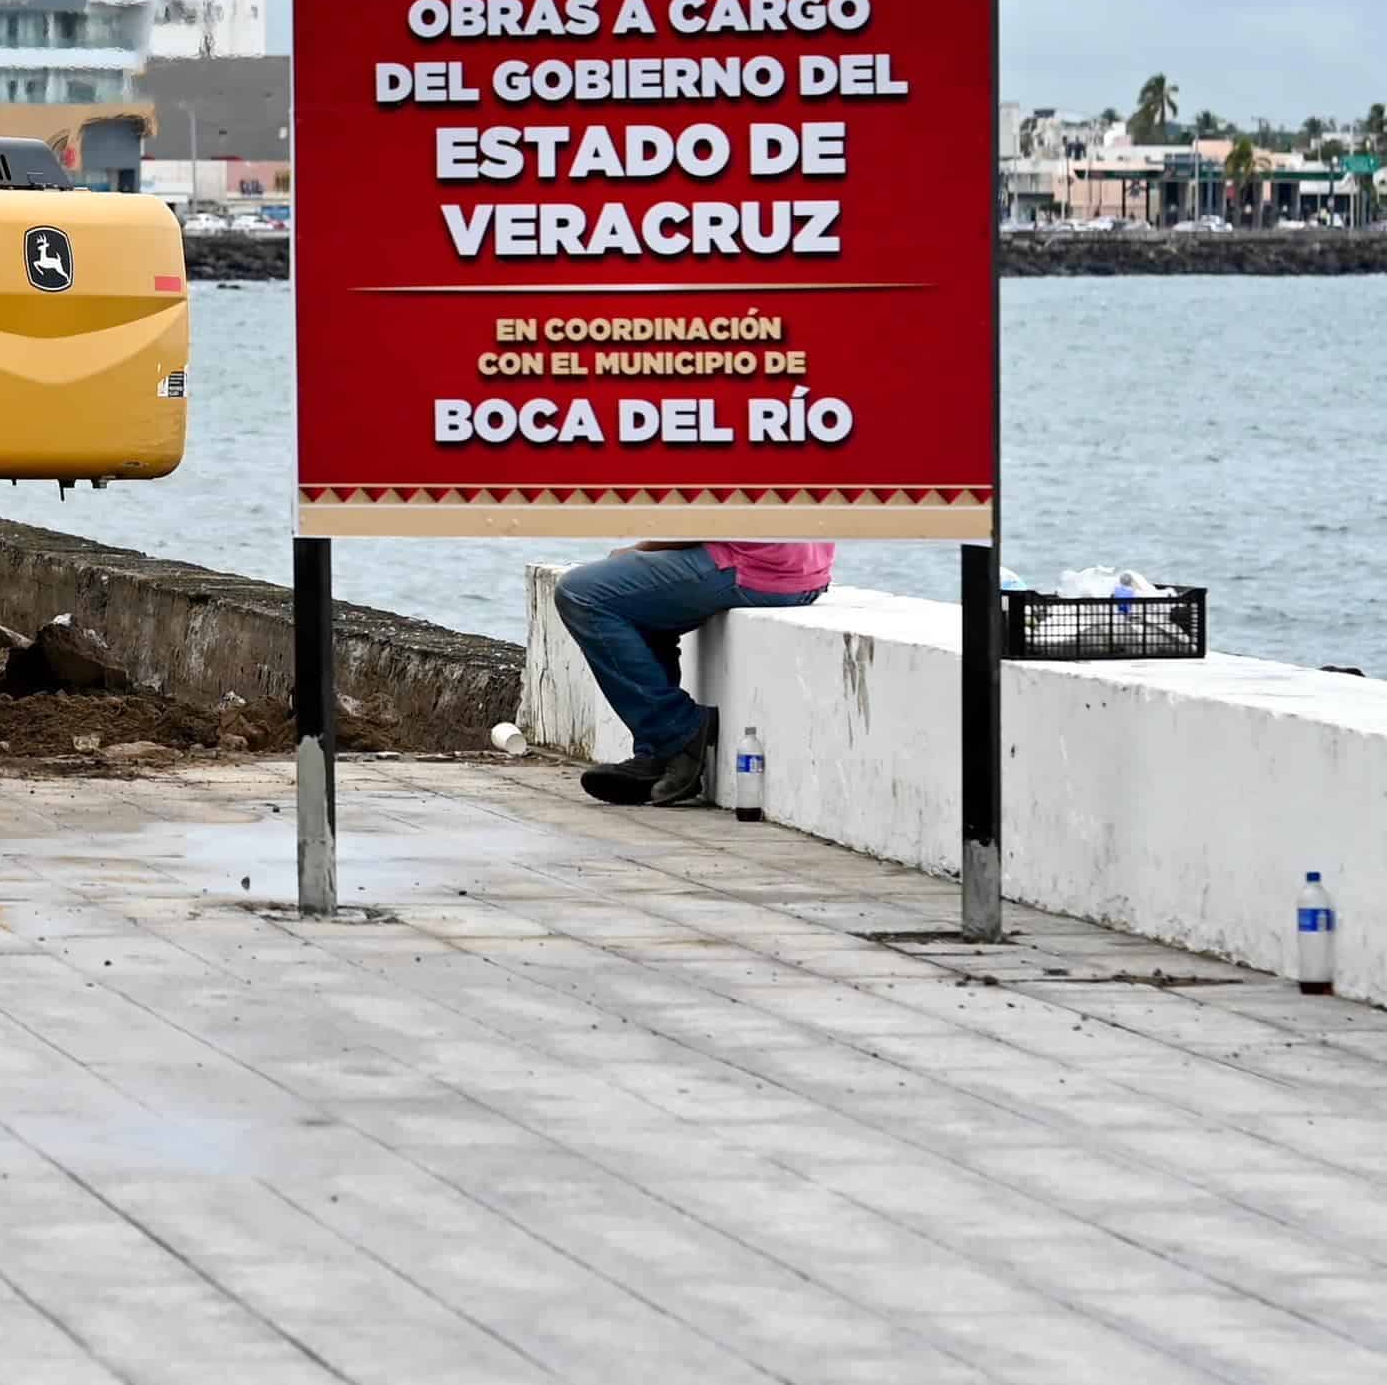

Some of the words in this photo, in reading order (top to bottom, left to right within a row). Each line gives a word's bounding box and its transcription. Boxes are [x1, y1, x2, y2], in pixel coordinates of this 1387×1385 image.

[376, 61, 479, 102] DEL
[492, 56, 785, 101] GOBIERNO
[799, 54, 908, 96] DEL
[436, 123, 729, 179] ESTADO
[749, 122, 846, 175] DE
[441, 200, 840, 256] VERACRUZ
[496, 318, 537, 342] EN
[544, 308, 781, 341] COORDINACIÓN
[478, 352, 543, 375] CON
[551, 352, 588, 375] EL
[595, 351, 757, 375] MUNICIPIO
[764, 351, 806, 374] DE
[434, 398, 604, 442] BOCA
[618, 398, 733, 441] DEL
[748, 385, 853, 442] RÍO
